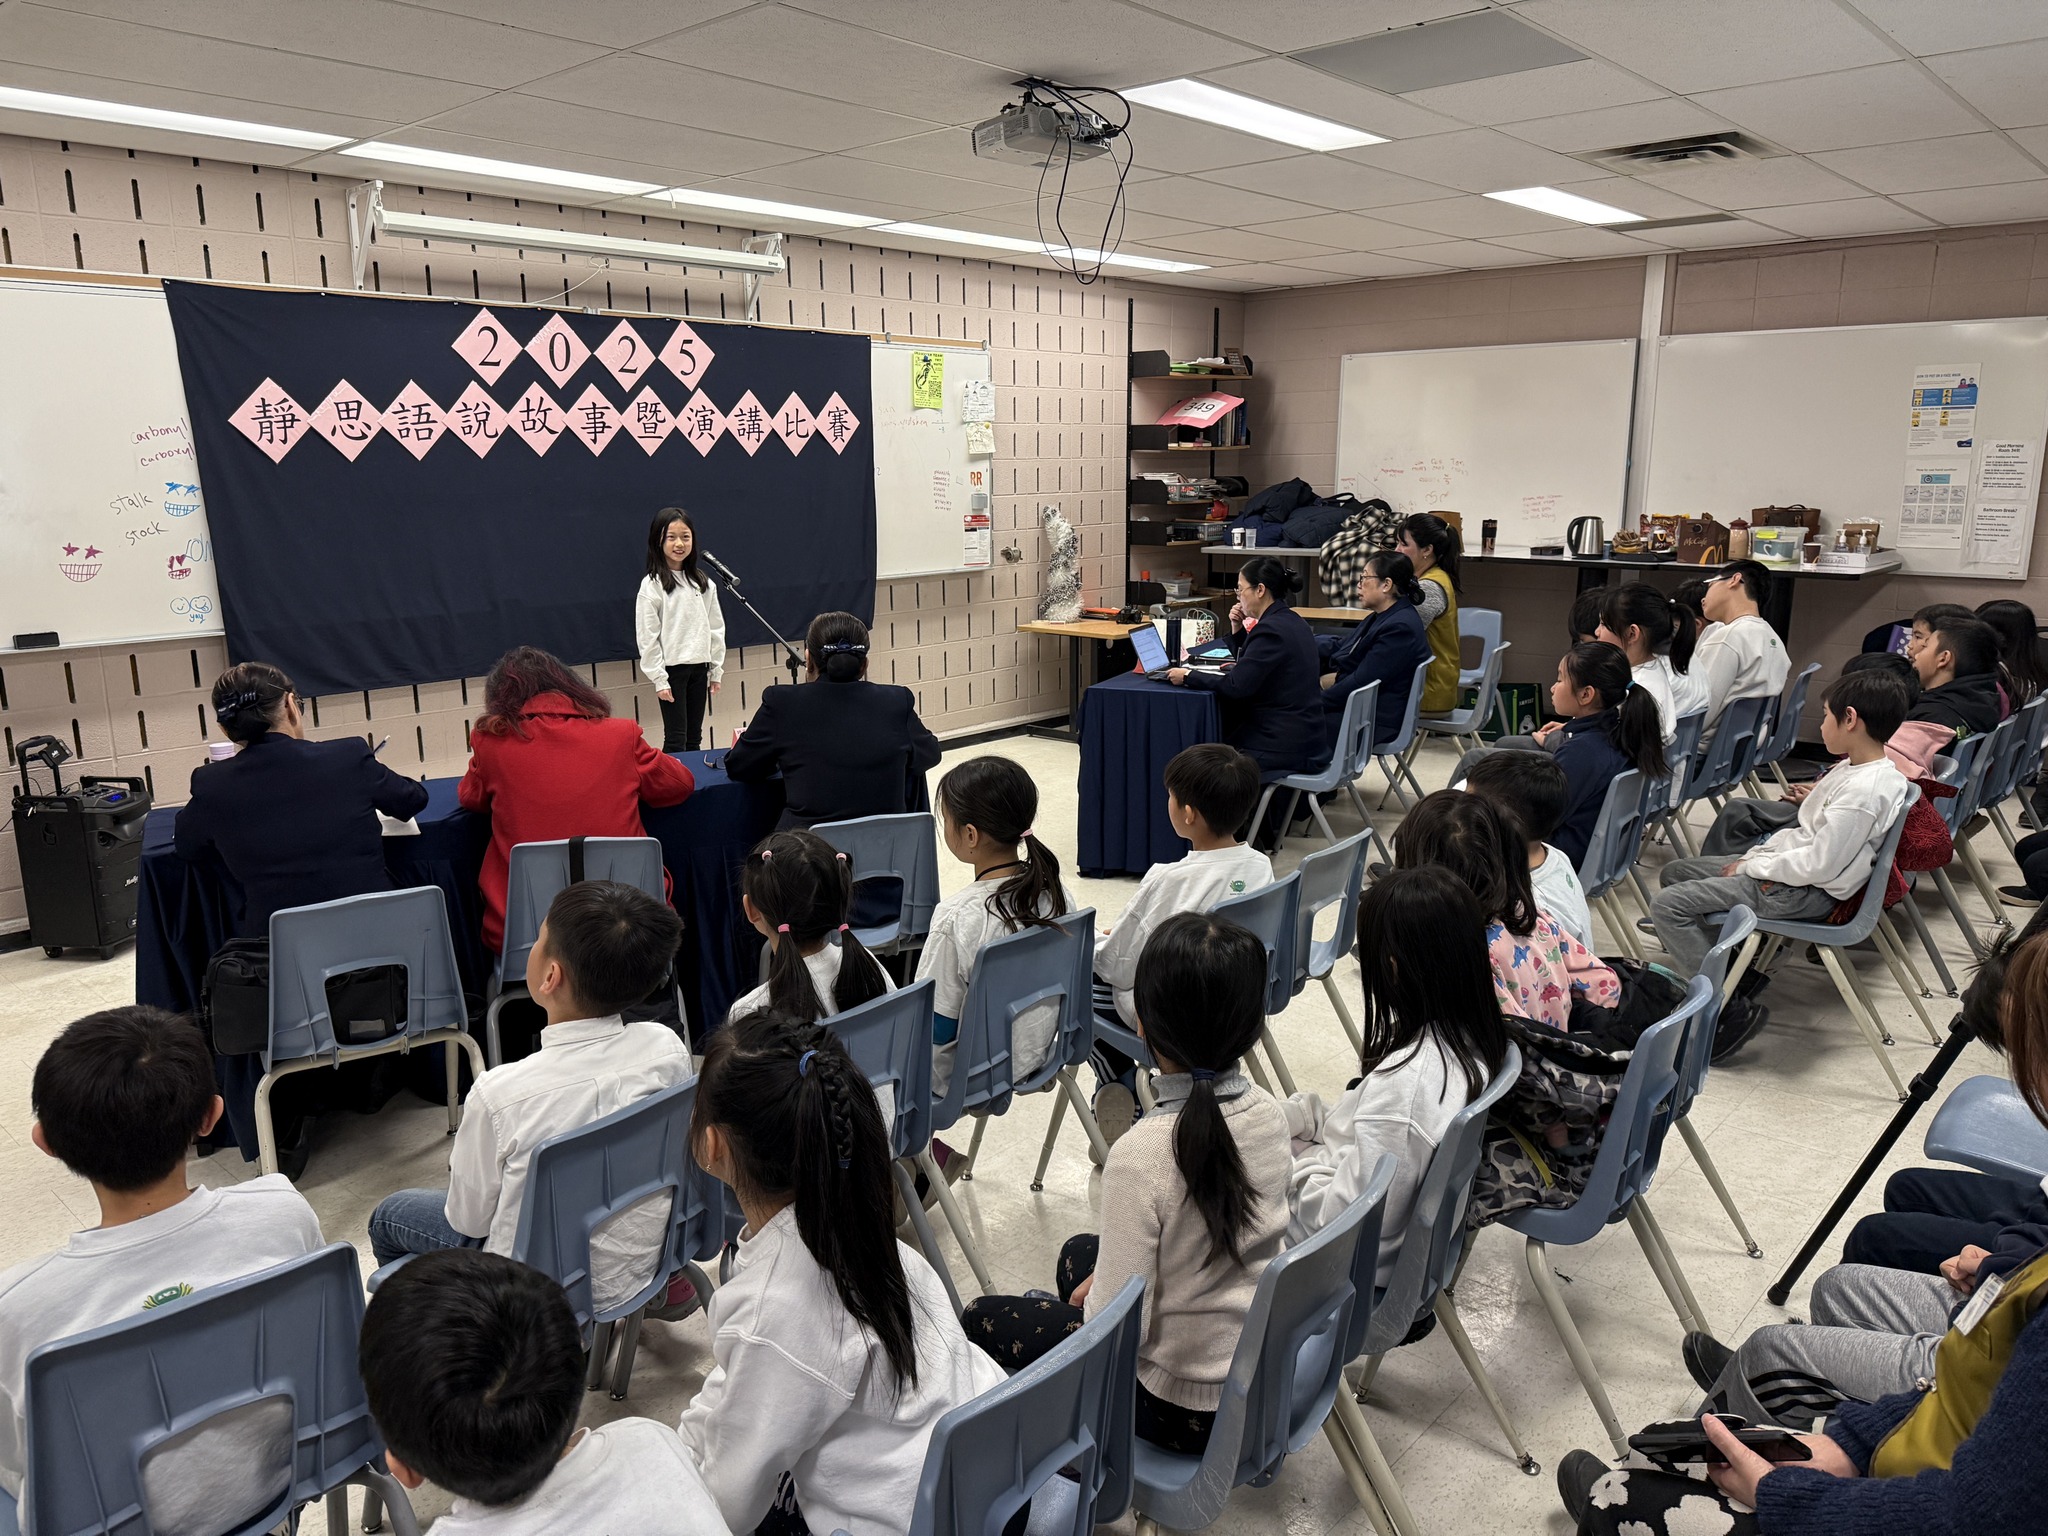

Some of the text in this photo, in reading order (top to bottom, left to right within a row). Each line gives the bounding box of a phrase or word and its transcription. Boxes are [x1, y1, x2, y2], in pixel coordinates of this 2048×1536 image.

[477, 326, 697, 376] 2025
[250, 396, 851, 445] 靜思語說故事暨演講比賽
[1184, 401, 1216, 413] 349
[970, 471, 983, 486] RR
